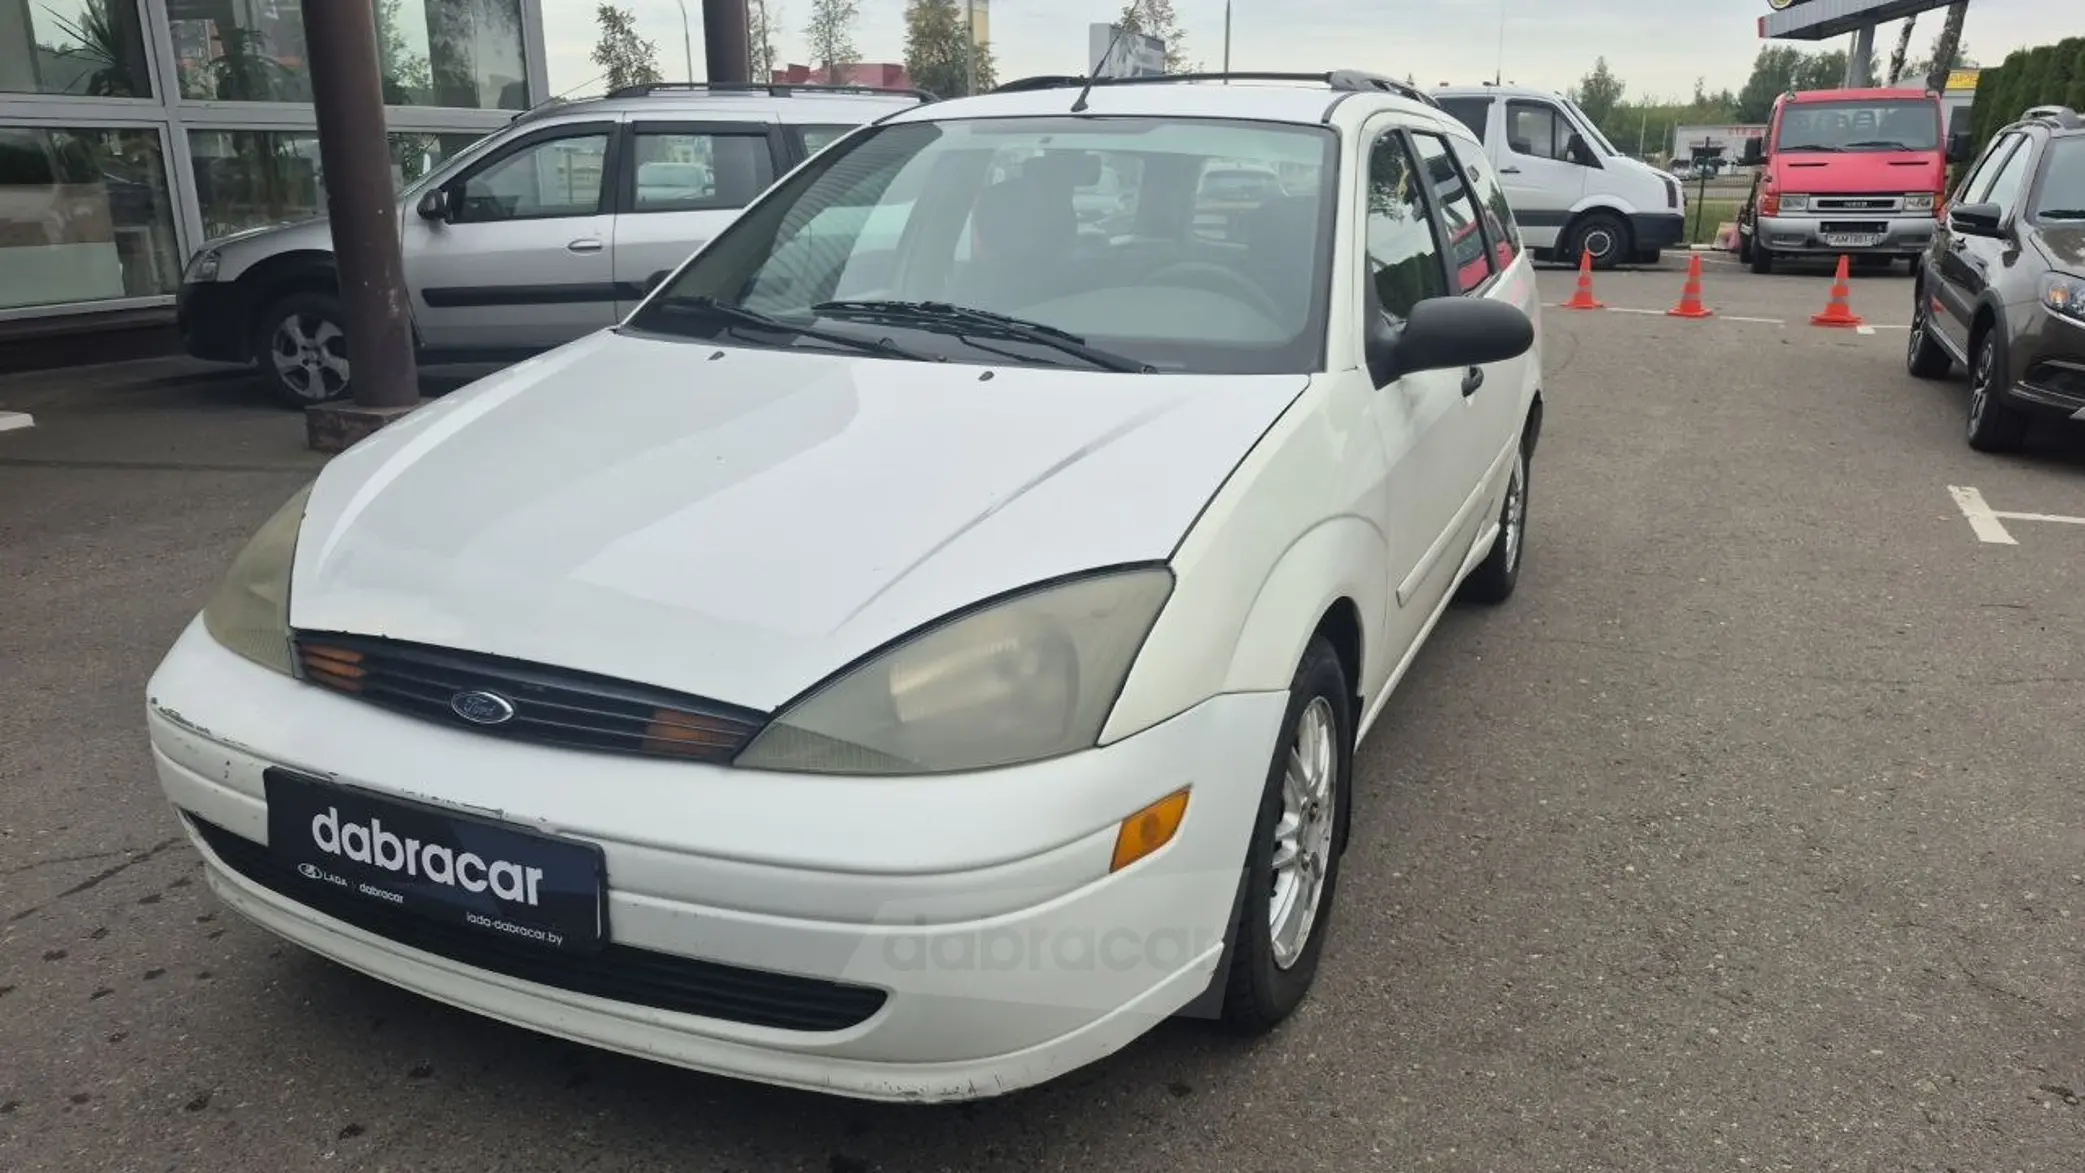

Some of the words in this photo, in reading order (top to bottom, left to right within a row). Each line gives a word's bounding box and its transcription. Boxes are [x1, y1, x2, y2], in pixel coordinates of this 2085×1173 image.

[311, 806, 544, 906] dabracar
[323, 872, 348, 887] LADA
[359, 882, 404, 903] dabracar
[466, 911, 563, 946] lada-dabracar.by
